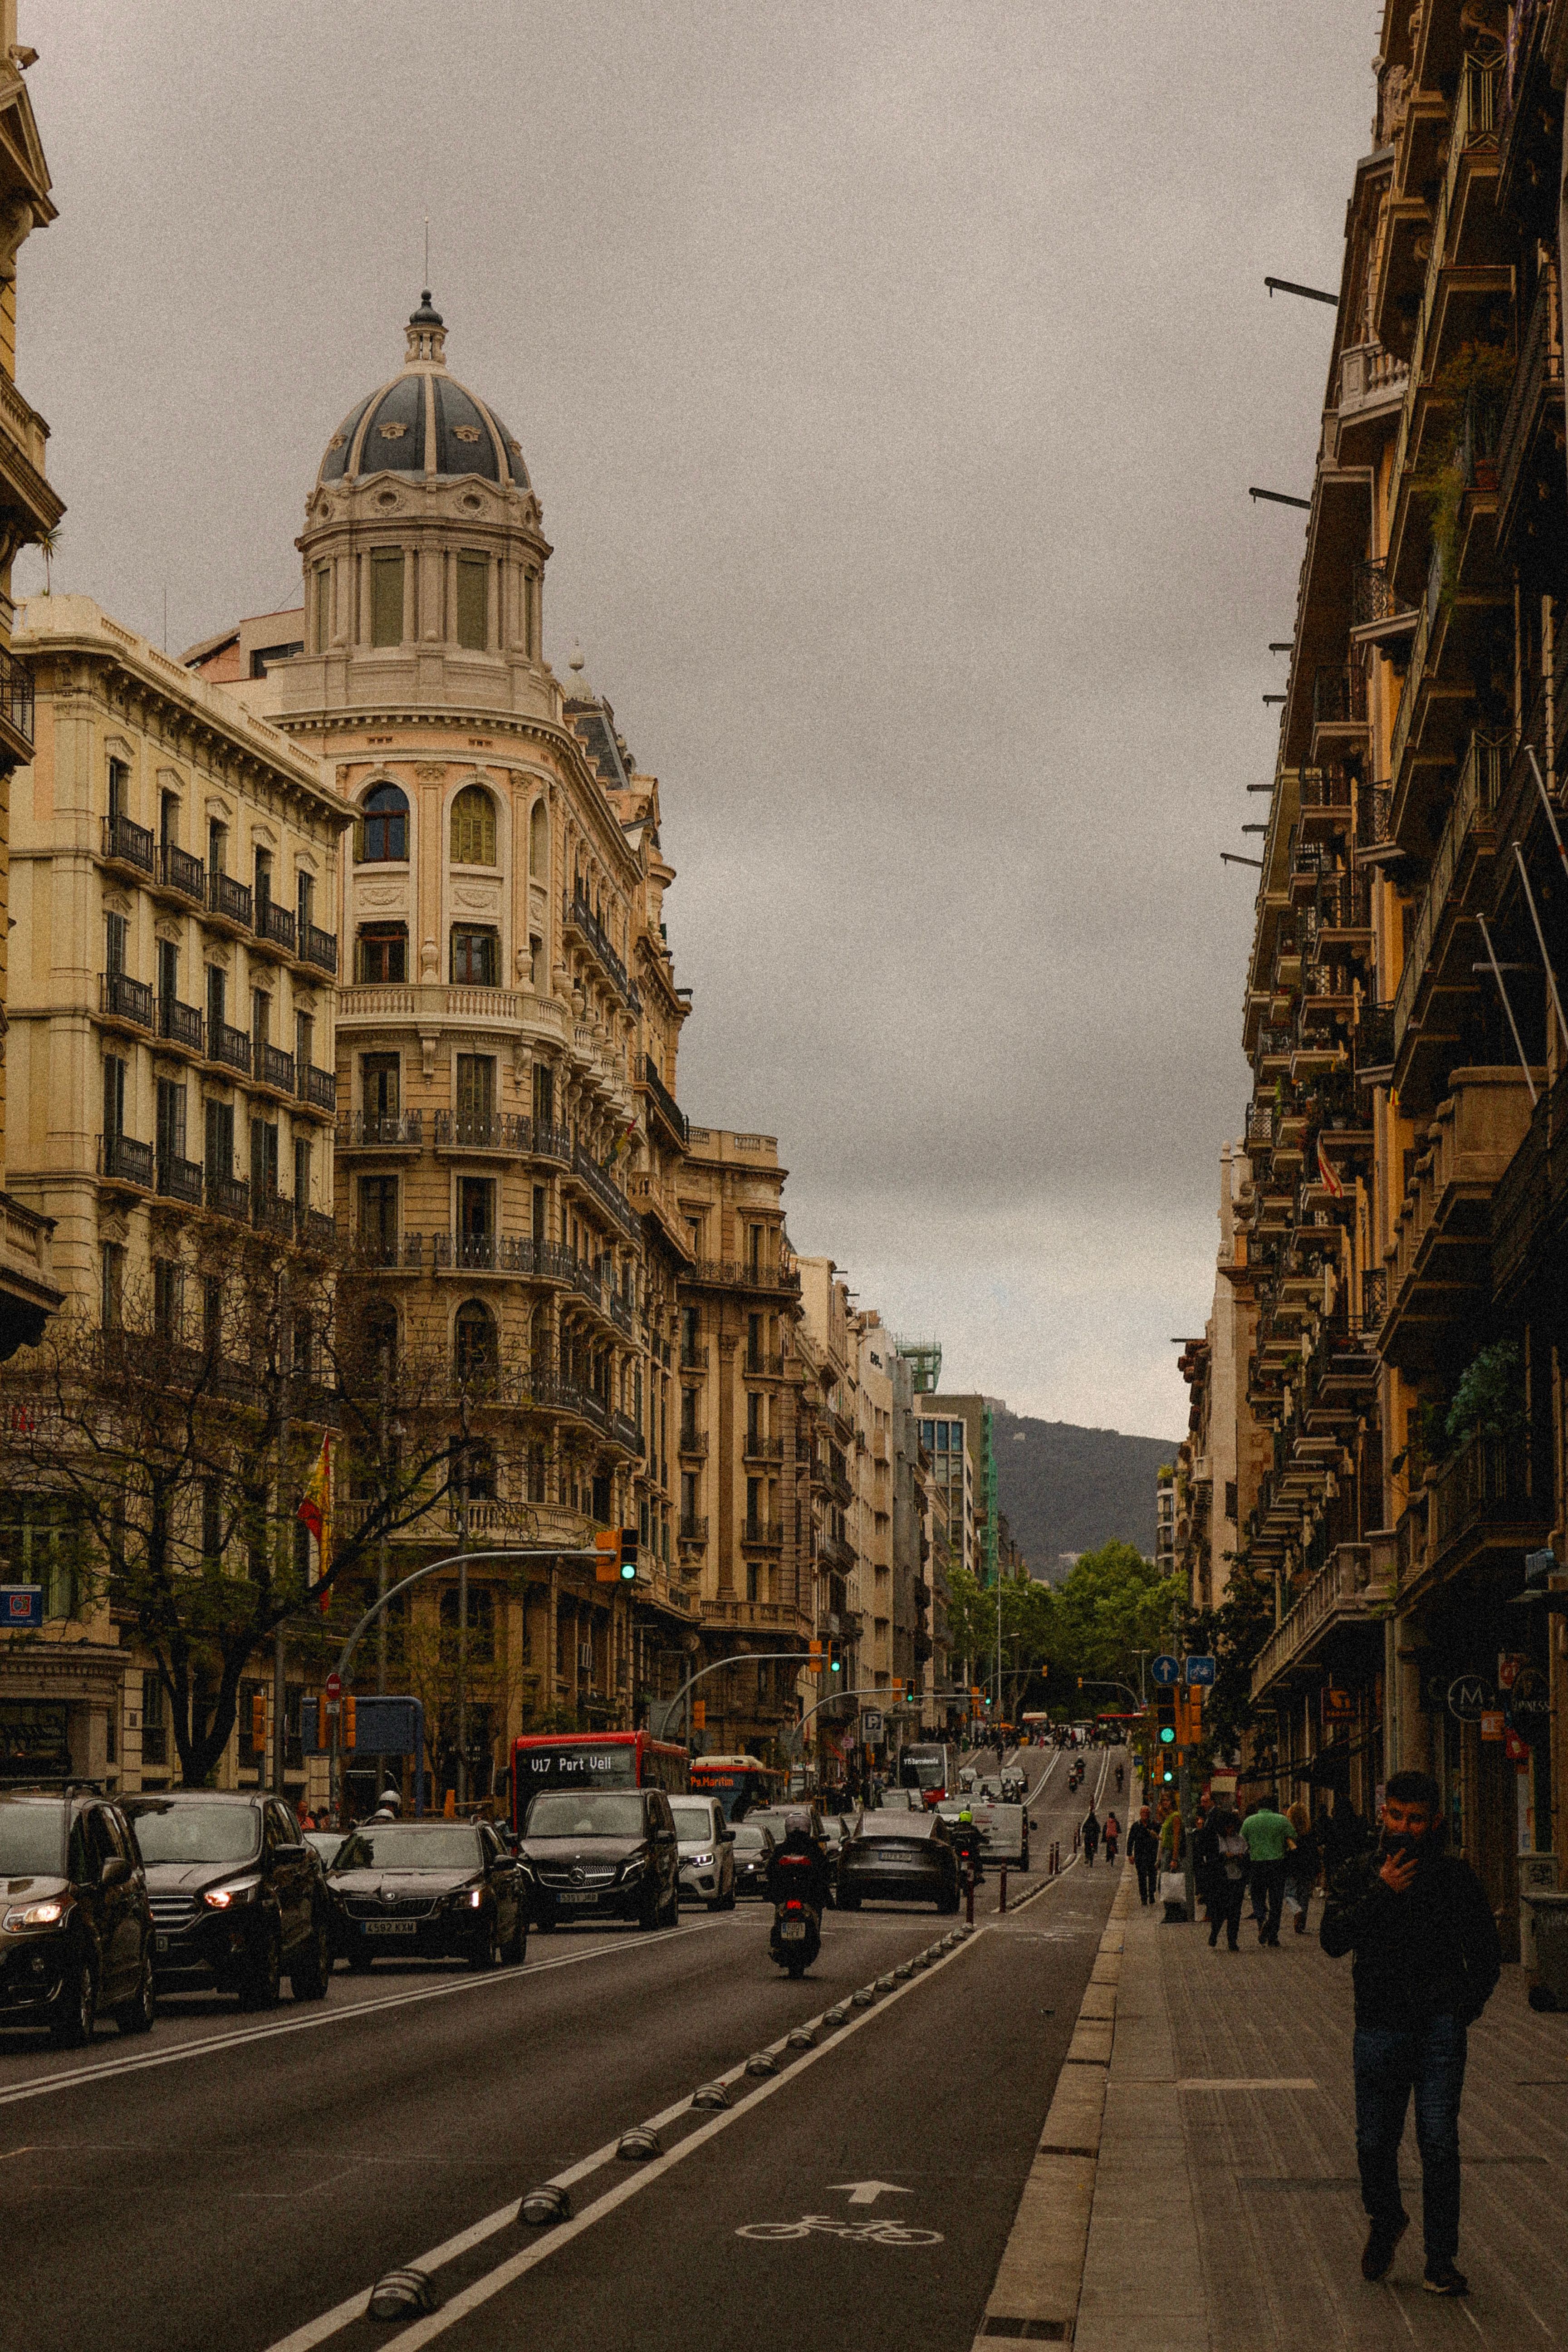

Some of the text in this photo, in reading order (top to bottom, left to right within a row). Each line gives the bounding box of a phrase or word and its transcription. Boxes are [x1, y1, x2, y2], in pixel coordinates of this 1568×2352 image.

[1460, 1684, 1483, 1704] M
[531, 1756, 612, 1772] V17 Port Vell
